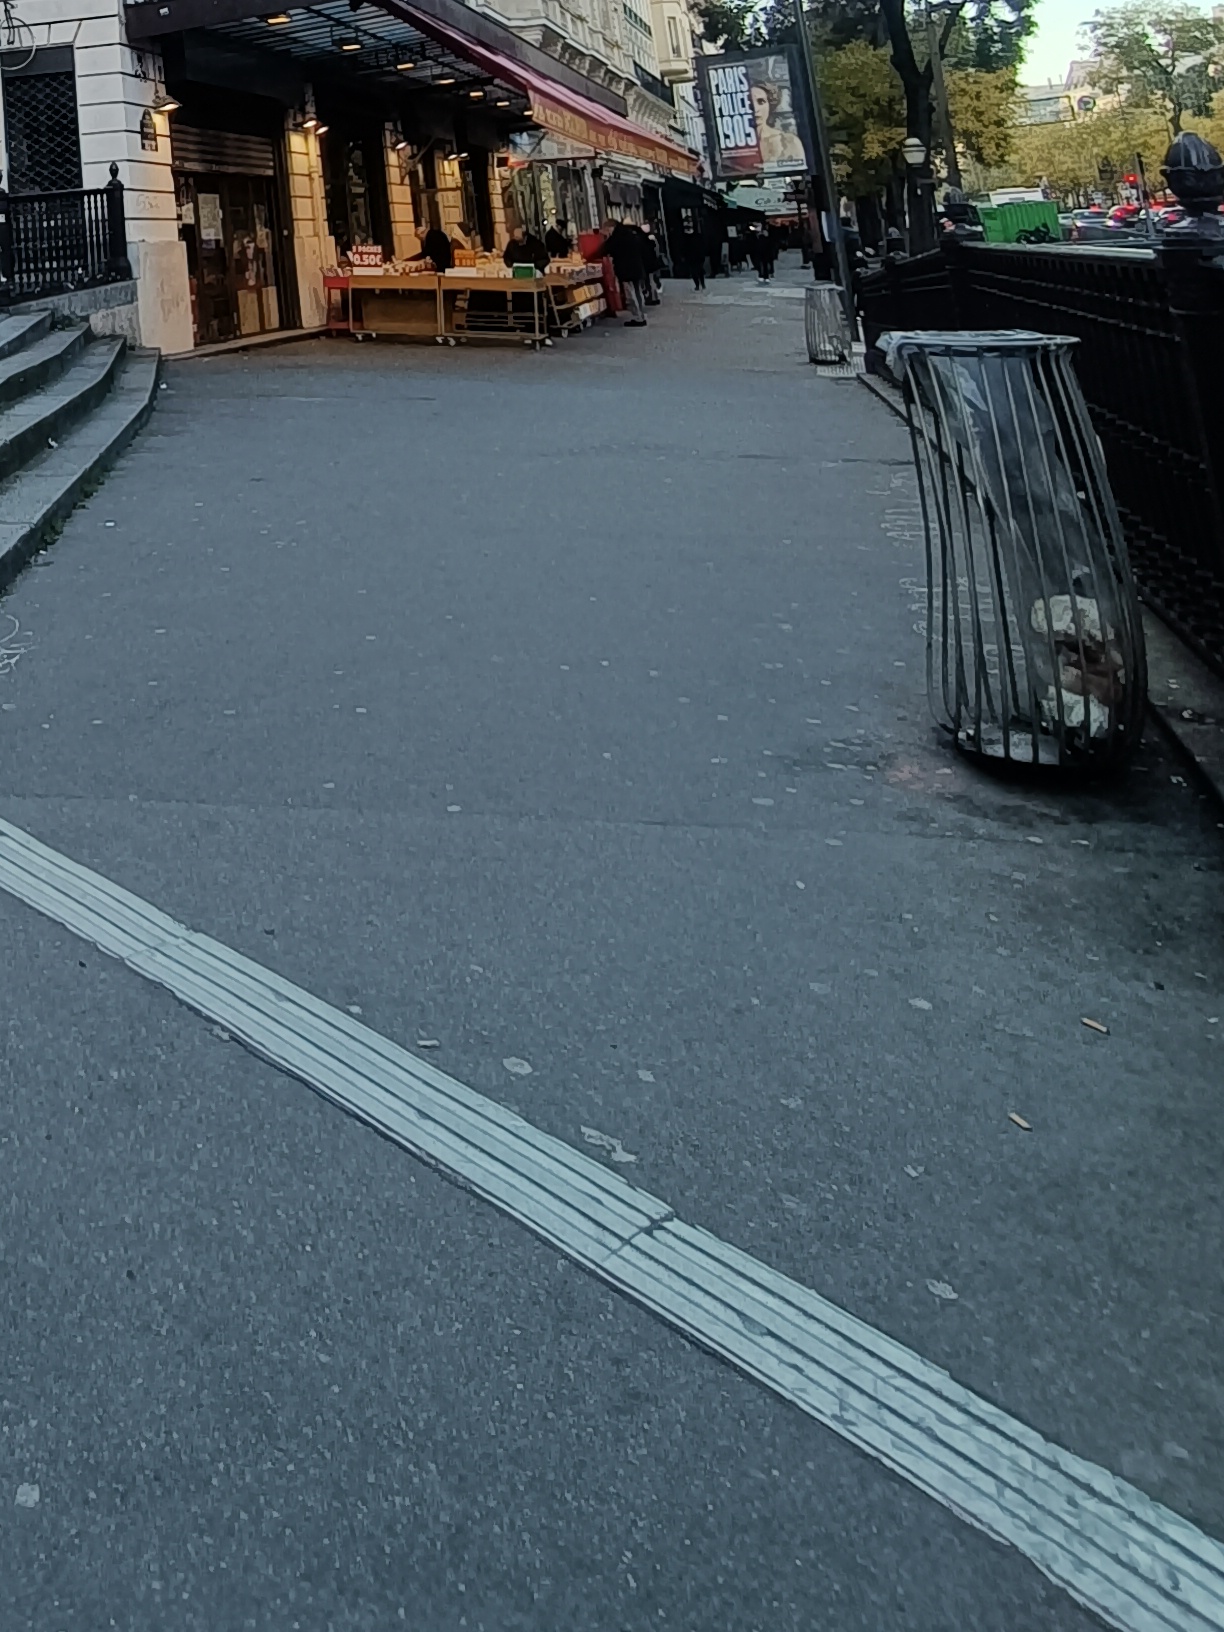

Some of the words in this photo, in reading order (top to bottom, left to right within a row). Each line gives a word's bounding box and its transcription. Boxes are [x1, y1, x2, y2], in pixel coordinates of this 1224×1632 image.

[708, 65, 750, 95] PARIS
[713, 91, 754, 117] POLICE
[716, 114, 758, 149] 1905
